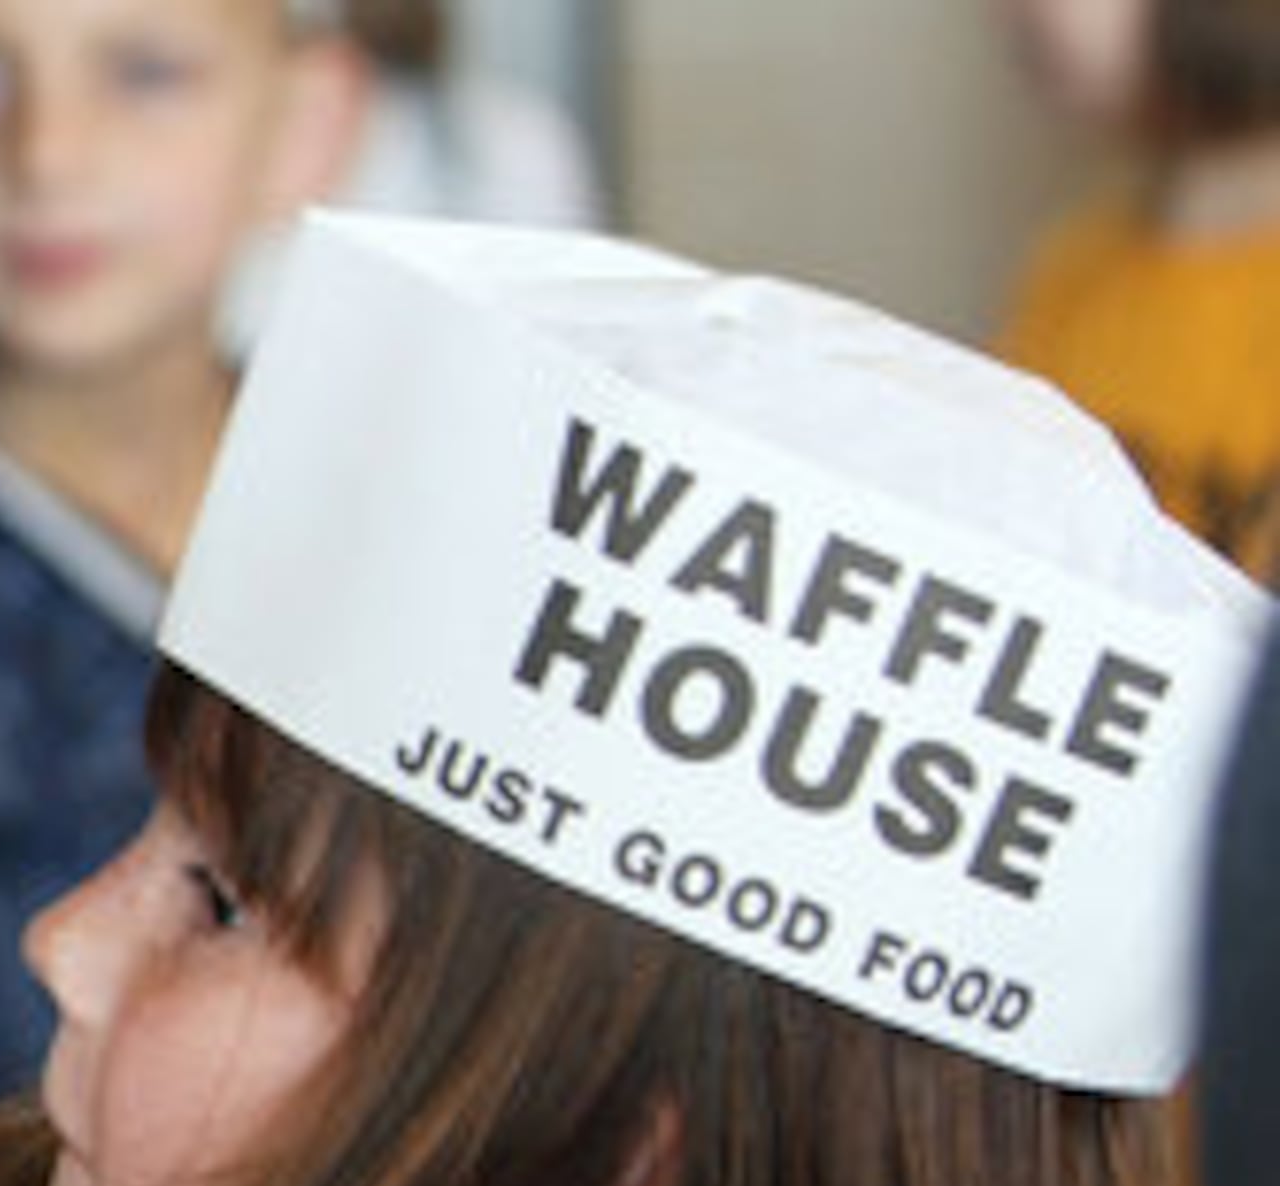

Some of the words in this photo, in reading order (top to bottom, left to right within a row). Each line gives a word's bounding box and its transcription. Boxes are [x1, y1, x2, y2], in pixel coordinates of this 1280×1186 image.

[511, 577, 1076, 902] HOUSE
[547, 415, 1172, 778] WAFFLE
[393, 726, 584, 844] JUST
[612, 829, 831, 955] GOOD
[857, 930, 1034, 1033] FOOD
